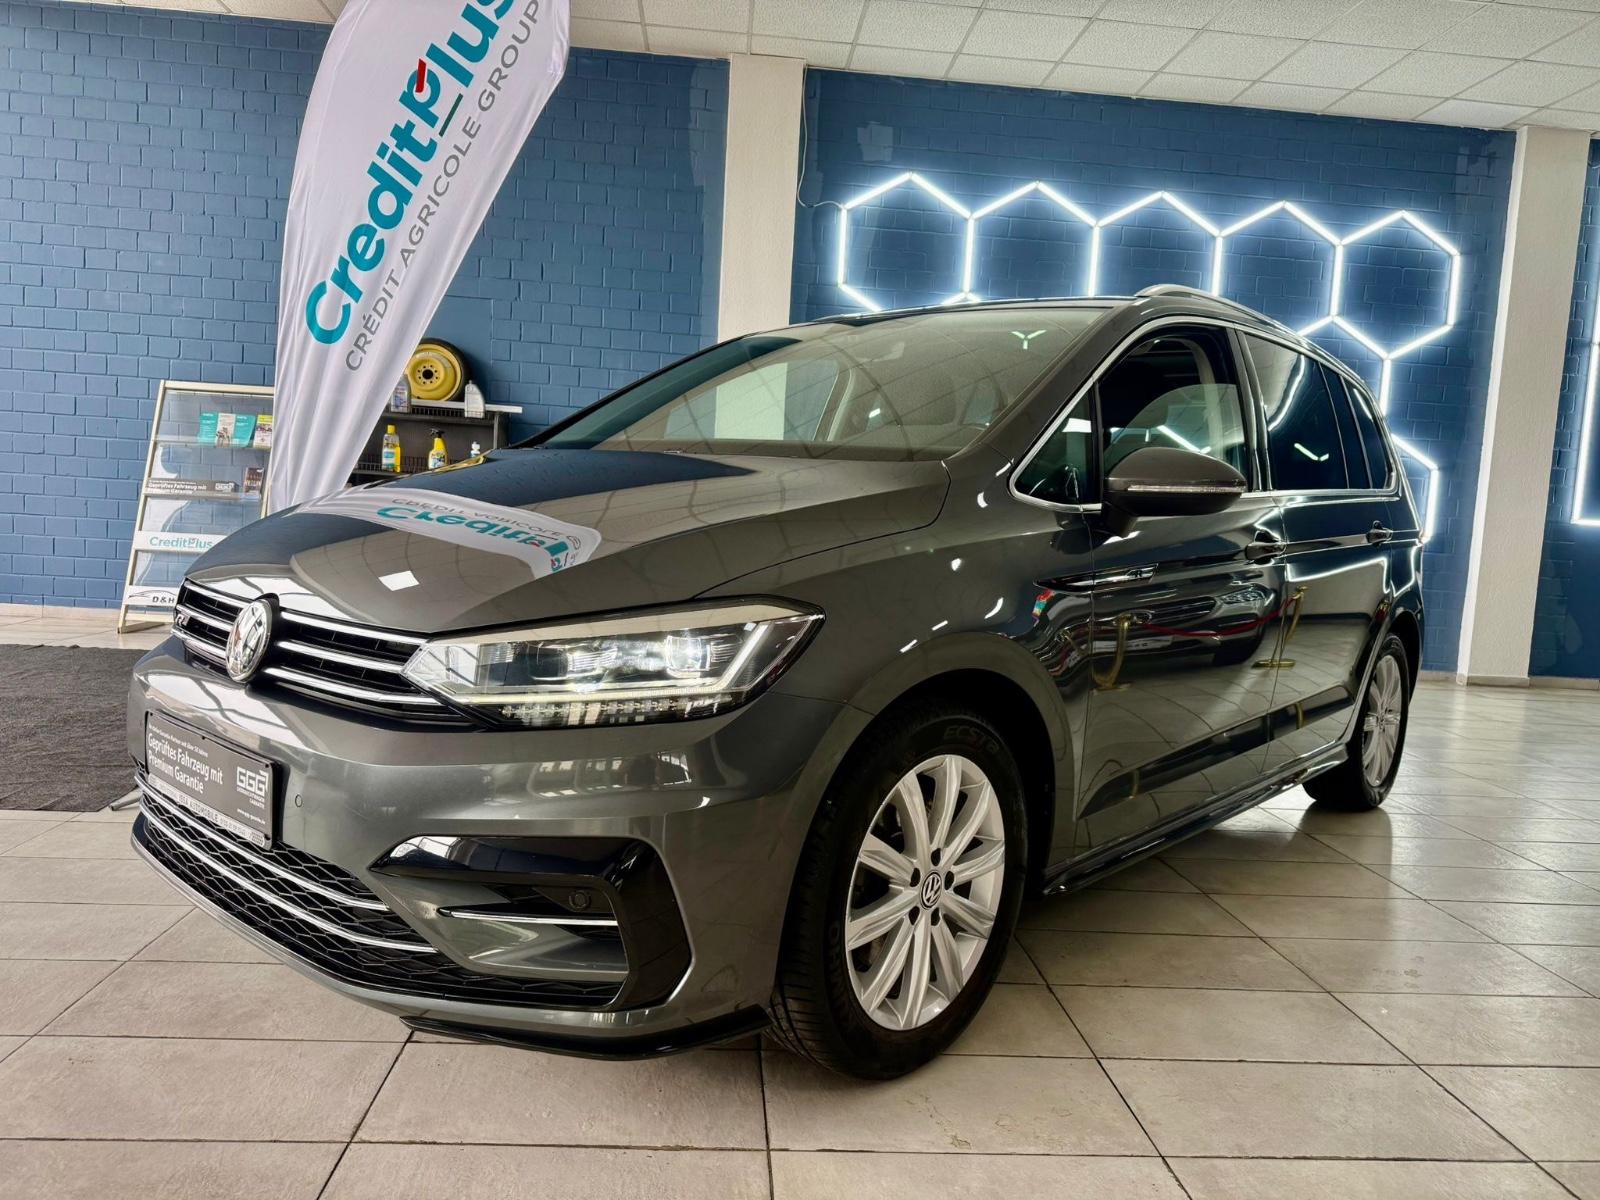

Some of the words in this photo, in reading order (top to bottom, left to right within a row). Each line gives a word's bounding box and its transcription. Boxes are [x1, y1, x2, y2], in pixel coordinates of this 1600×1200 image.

[345, 268, 400, 371] CRÉDIT
[400, 116, 482, 268] AGRICOLE
[478, 0, 539, 111] GROUP
[150, 535, 213, 549] CreditPlus
[148, 732, 177, 761] Geprüftes
[177, 747, 210, 782] Fahrzeug
[210, 767, 223, 785] mit
[174, 766, 204, 794] Garantie
[236, 766, 266, 798] GGG
